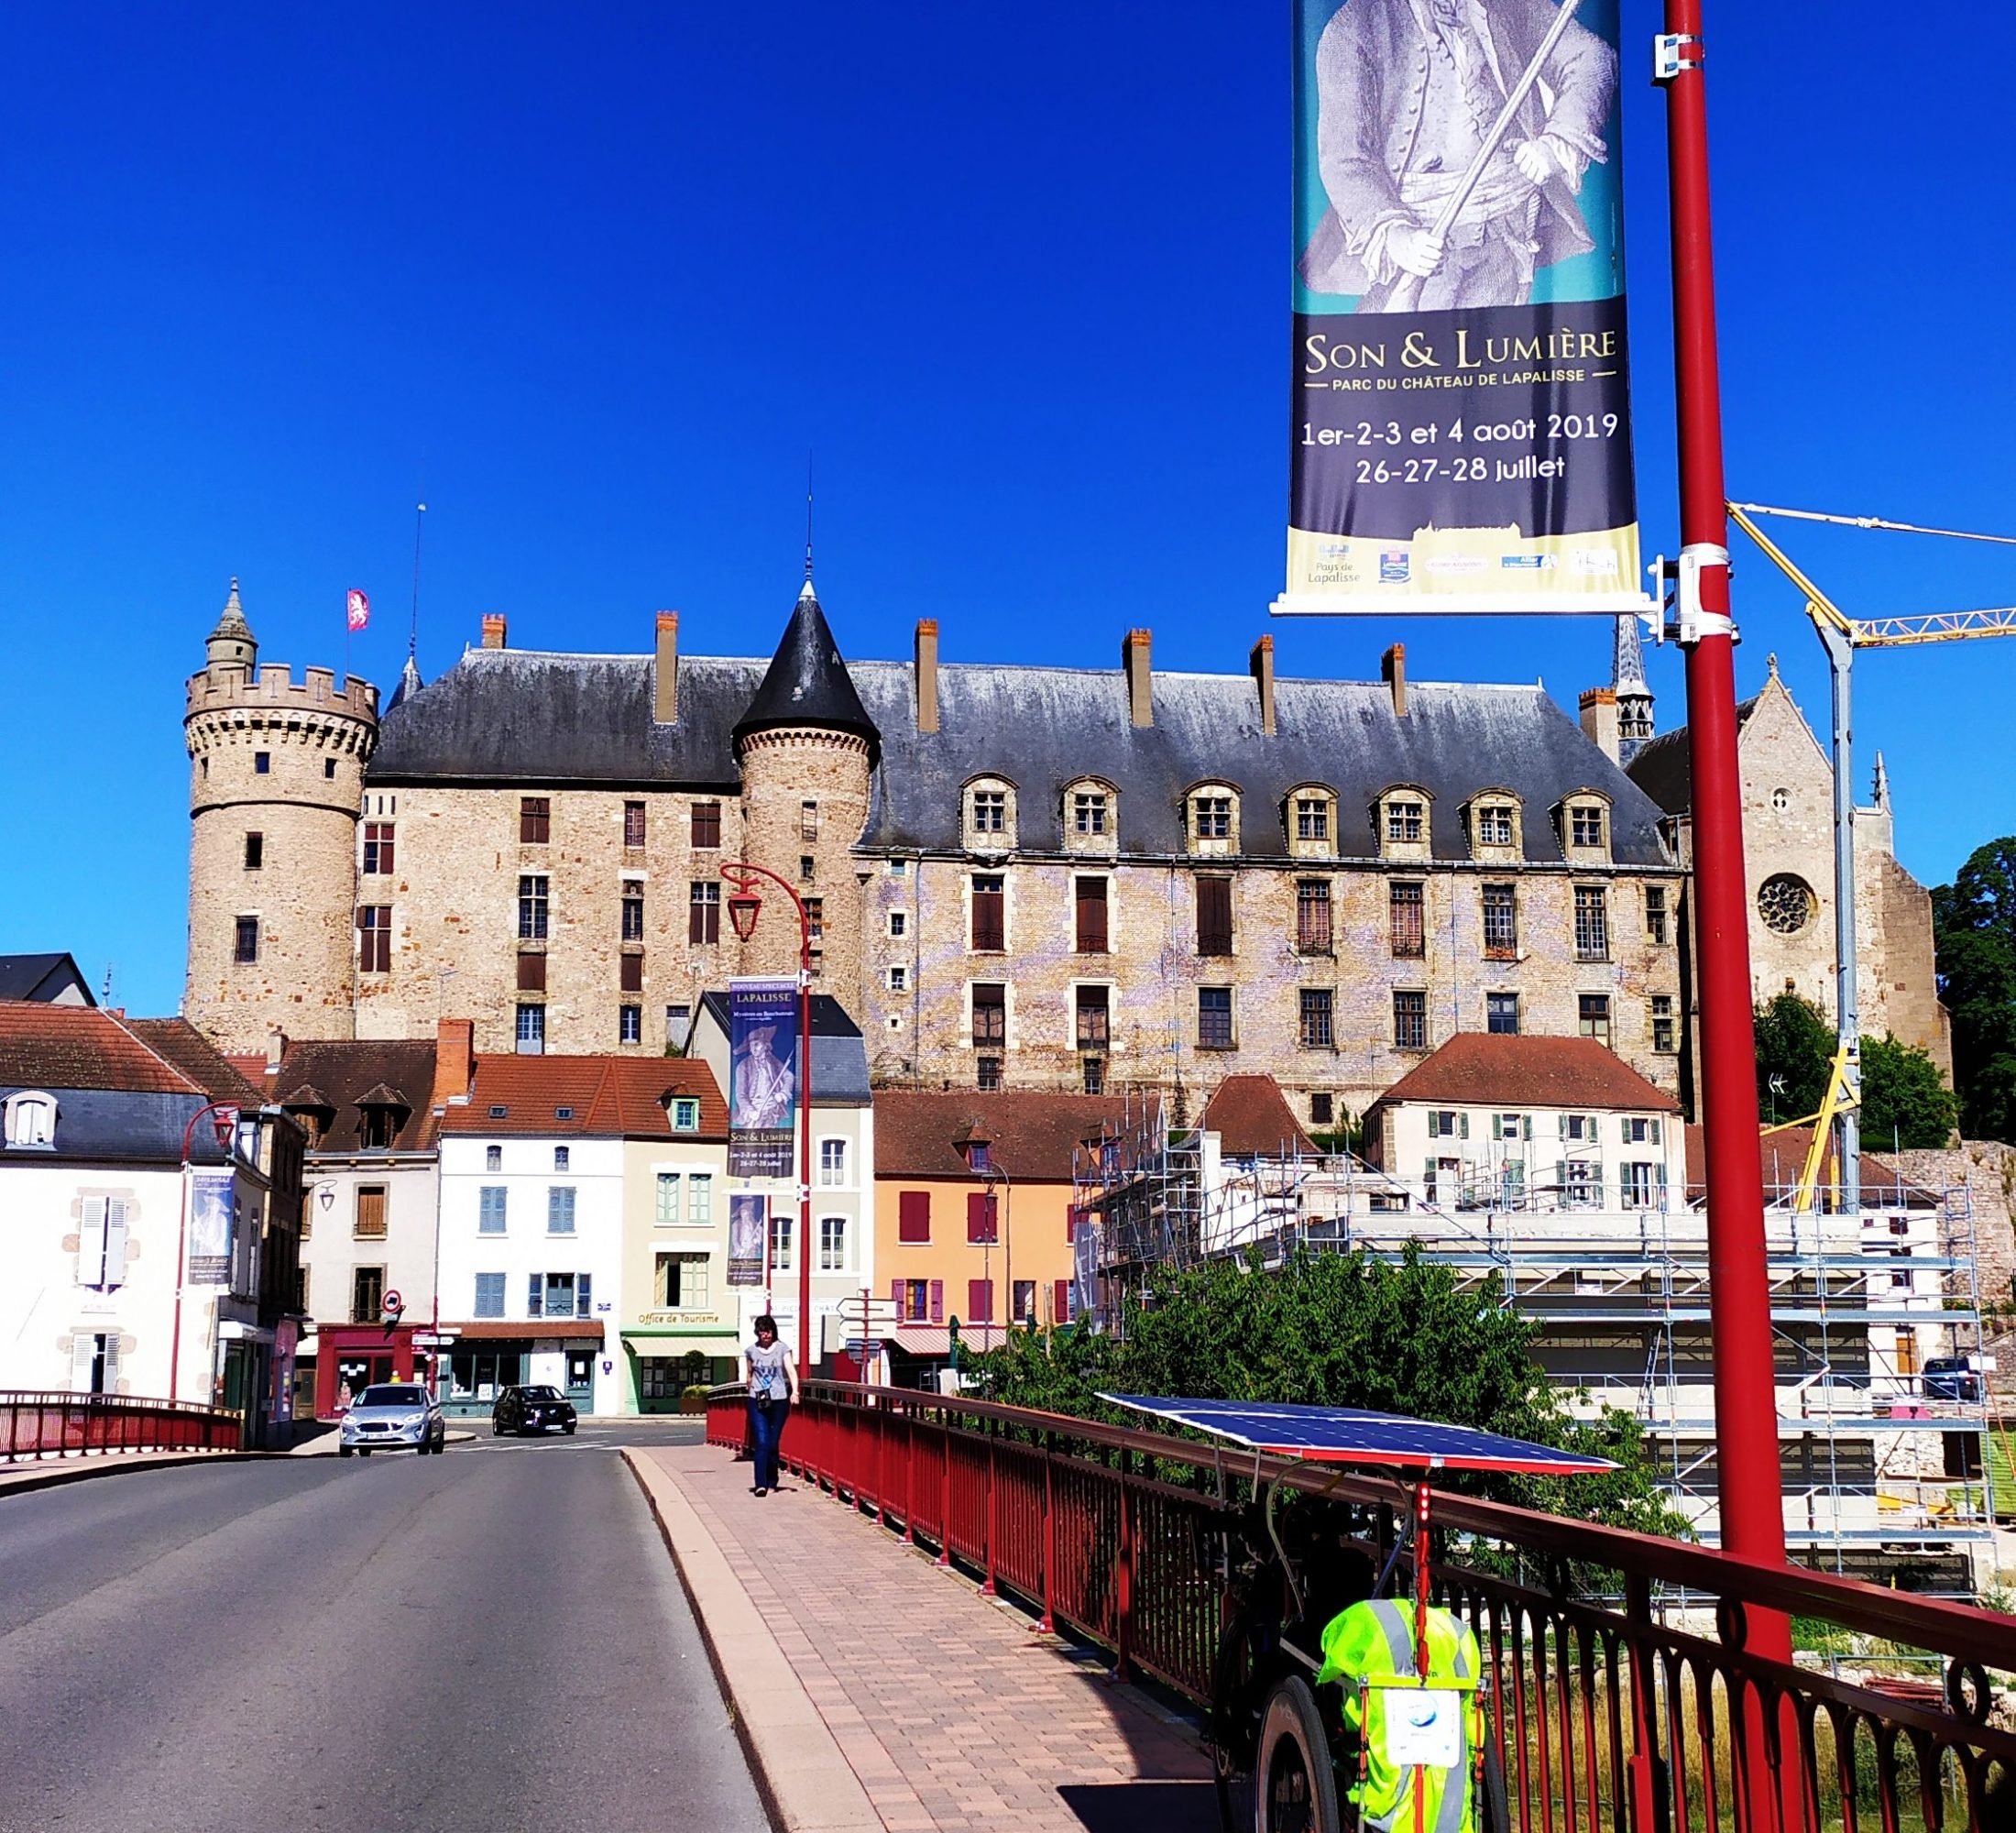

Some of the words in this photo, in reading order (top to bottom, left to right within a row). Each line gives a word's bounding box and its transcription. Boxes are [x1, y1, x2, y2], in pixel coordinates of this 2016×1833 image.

[1305, 334, 1386, 374] SON
[1400, 331, 1441, 368] &
[1454, 327, 1616, 368] LUMIÈRE
[1332, 379, 1372, 390] PARC
[1376, 378, 1397, 390] DU
[1401, 375, 1473, 390] CHÂTEAU
[1478, 373, 1498, 386] DE
[1502, 369, 1585, 385] LAPALISSE
[1301, 421, 1402, 445] 1er-2-3
[1409, 423, 1438, 445] et
[1447, 417, 1463, 443] 4
[1473, 418, 1537, 442] août
[1547, 412, 1618, 439] 2019
[1355, 456, 1488, 484] 26-27-28
[1495, 455, 1565, 482] juillet
[1316, 562, 1339, 576] Pays
[1342, 562, 1353, 571] de
[1308, 571, 1361, 585] Lapalisse
[737, 993, 792, 1003] LAPALISSE
[750, 1132, 759, 1141] &
[638, 1312, 663, 1325] Office
[666, 1313, 677, 1323] de
[680, 1314, 719, 1323] Tourisme
